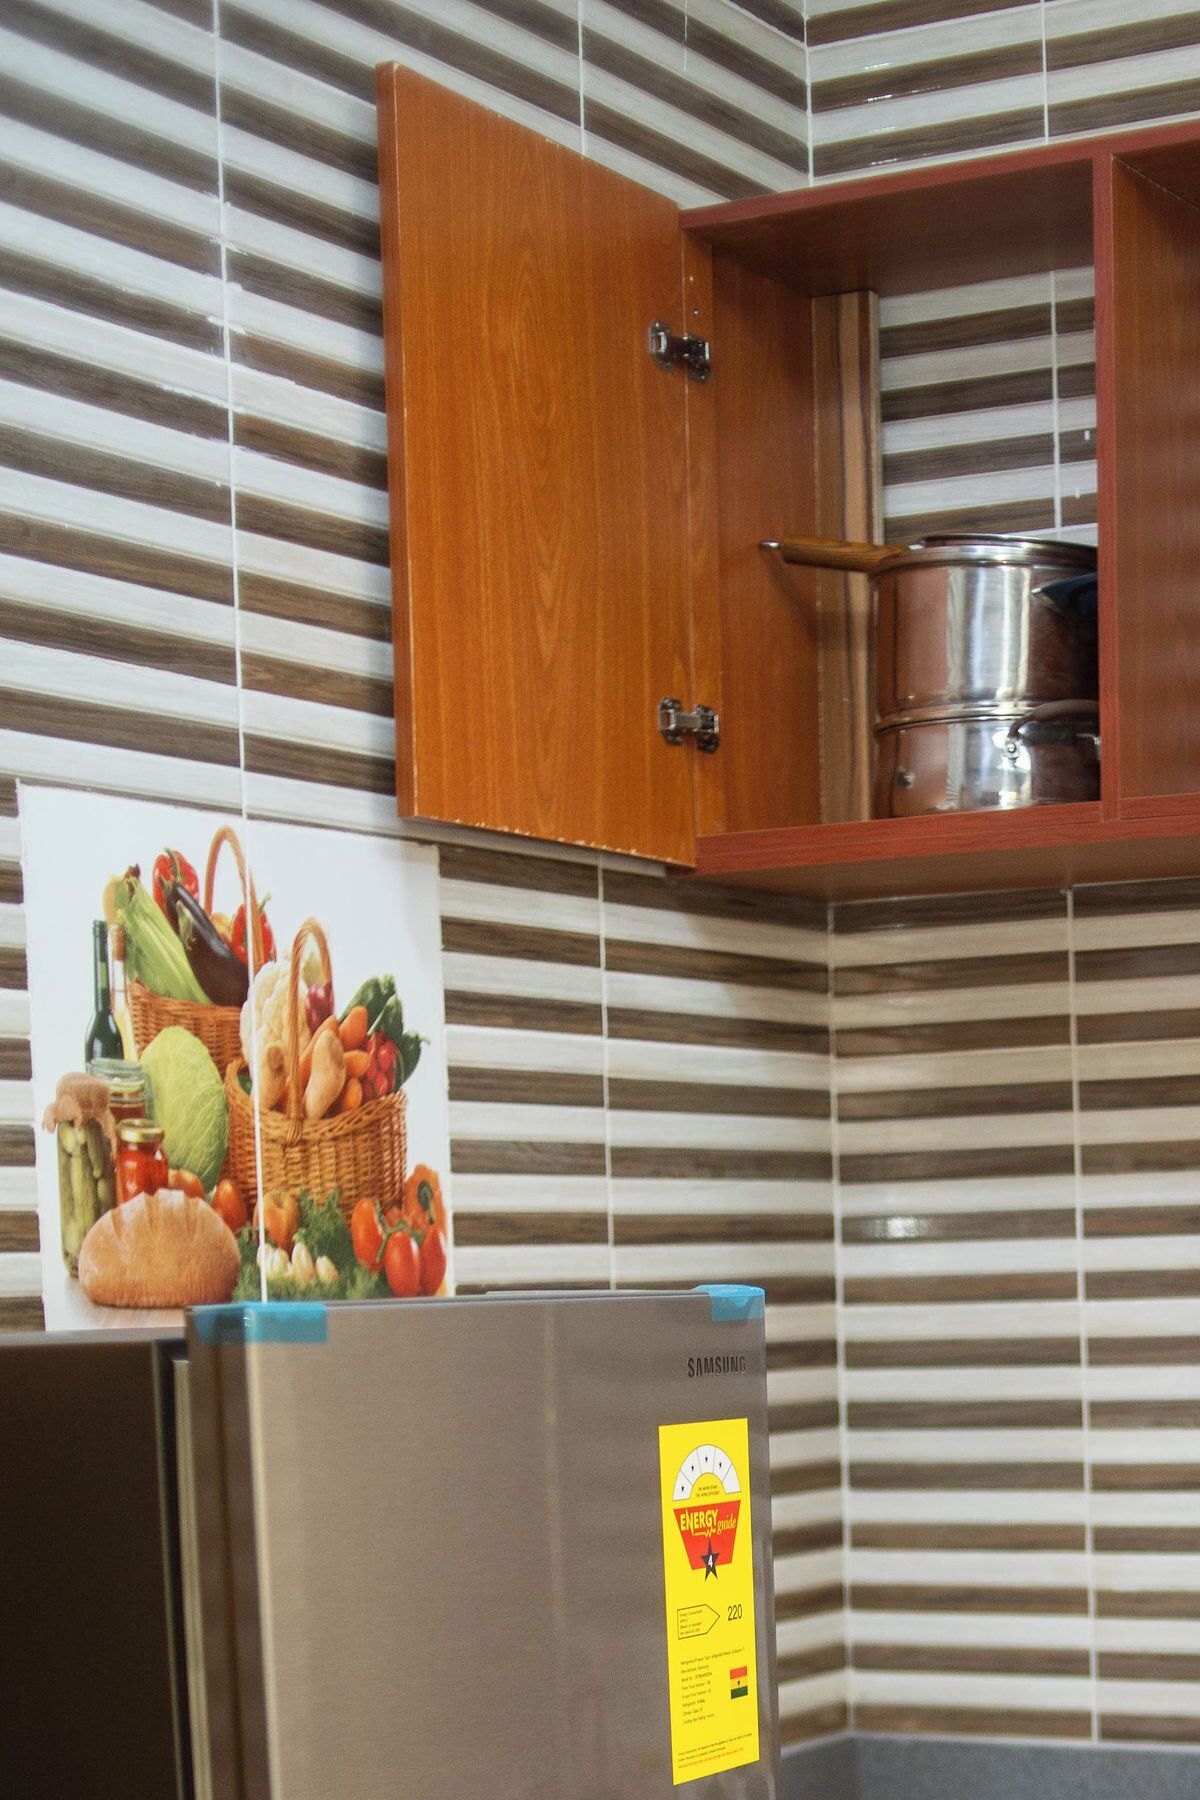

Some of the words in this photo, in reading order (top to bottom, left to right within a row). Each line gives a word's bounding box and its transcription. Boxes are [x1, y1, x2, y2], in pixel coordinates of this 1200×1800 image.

[688, 1356, 746, 1378] SAMSUNG
[680, 1508, 719, 1535] ENERGY
[717, 1513, 737, 1535] guide
[708, 1554, 714, 1568] 4
[728, 1604, 743, 1621] 220
